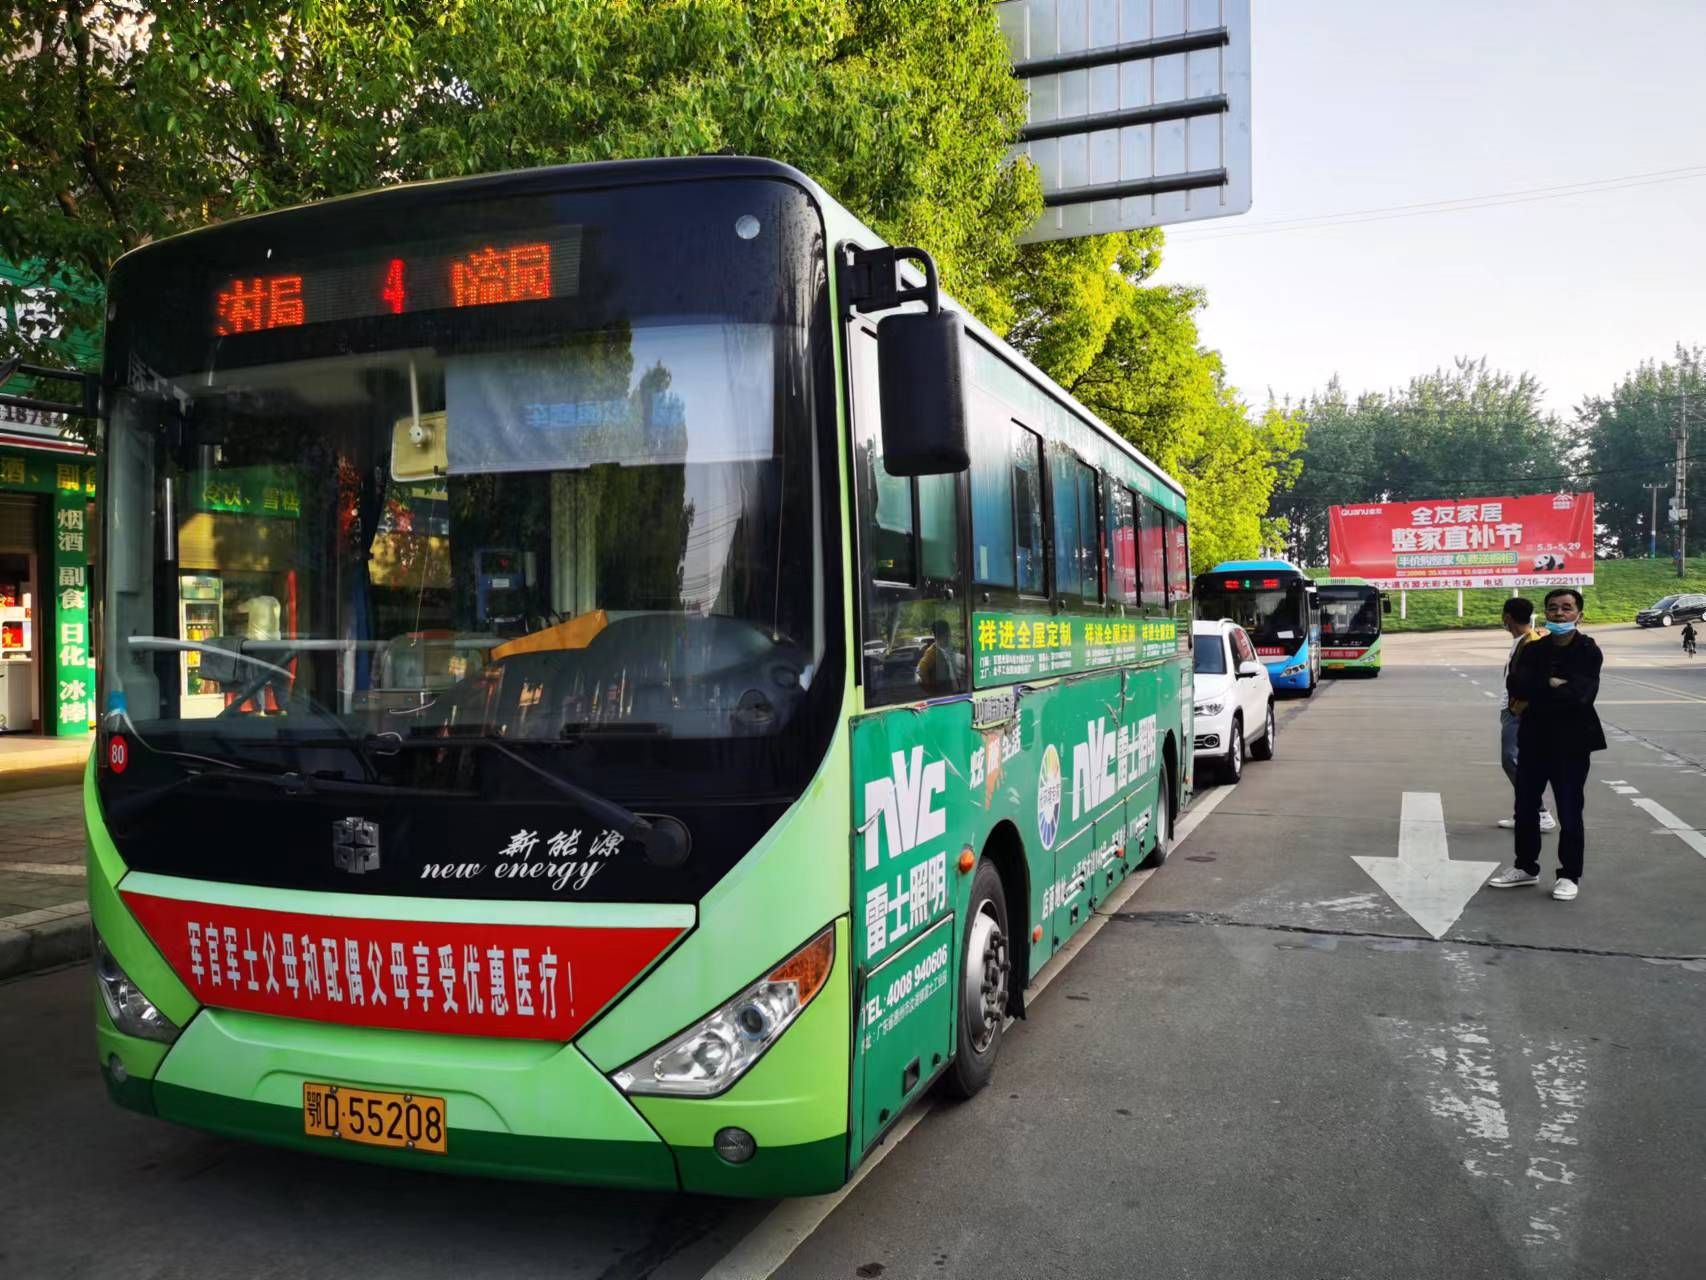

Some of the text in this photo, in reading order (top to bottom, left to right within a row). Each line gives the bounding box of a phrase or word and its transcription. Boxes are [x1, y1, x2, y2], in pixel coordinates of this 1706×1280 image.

[383, 257, 406, 314] 4
[1411, 503, 1503, 526] 全友家居
[1392, 524, 1523, 552] 整家直补节
[1483, 578, 1504, 587] 电话
[57, 508, 86, 724] 烟酒 副食 日化 冰棒
[978, 620, 1072, 651] 祥进全屋定制
[111, 744, 124, 764] 80
[498, 828, 624, 860] 新能源
[421, 858, 606, 891] new energy
[866, 851, 947, 959] 雷士照明
[886, 970, 913, 1007] 4008
[914, 944, 948, 987] 940606
